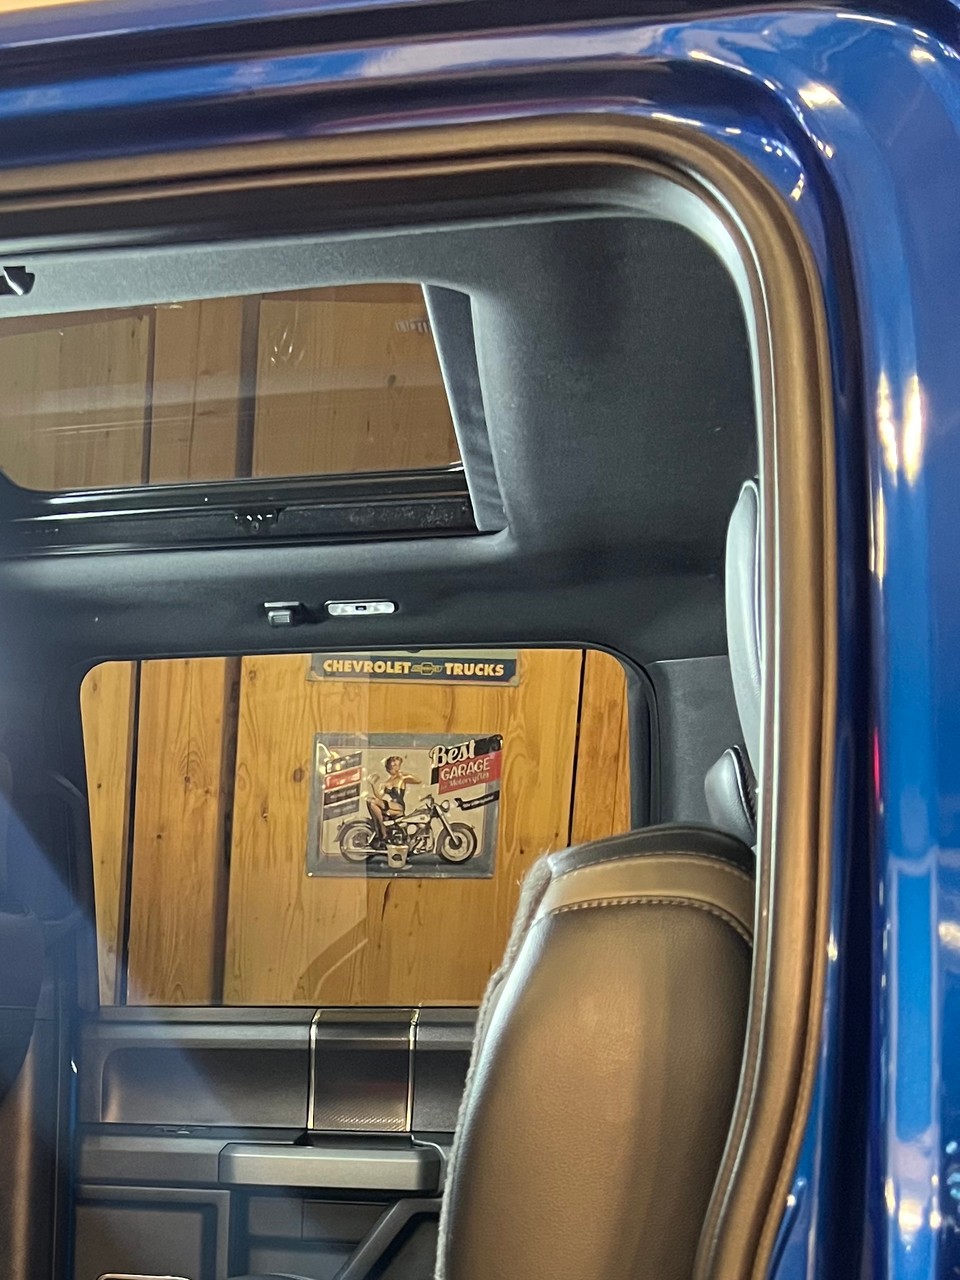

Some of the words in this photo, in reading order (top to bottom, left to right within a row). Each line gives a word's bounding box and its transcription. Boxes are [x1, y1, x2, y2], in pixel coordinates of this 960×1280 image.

[323, 659, 411, 674] CHEVROLET
[445, 662, 505, 677] TRUCKS
[429, 739, 475, 768] Best
[441, 756, 491, 781] GARAGE
